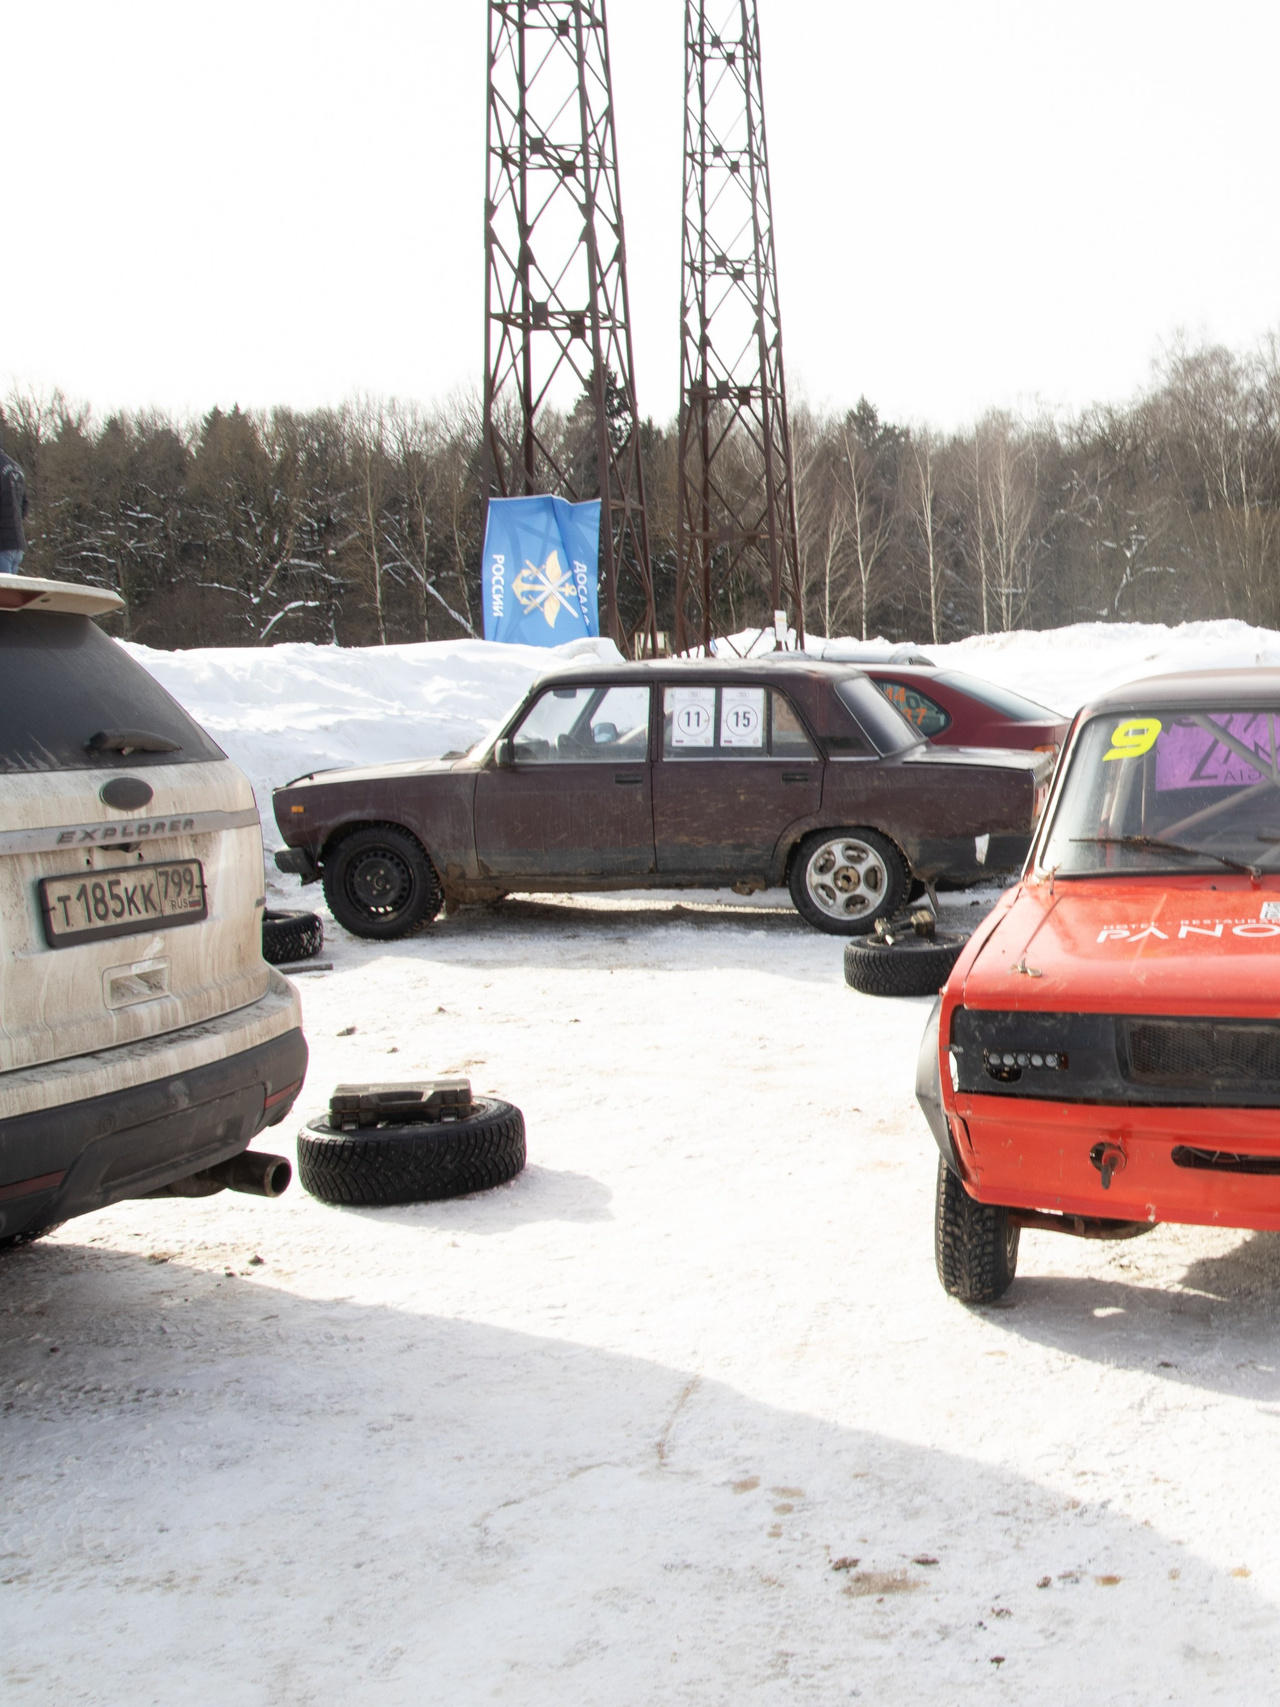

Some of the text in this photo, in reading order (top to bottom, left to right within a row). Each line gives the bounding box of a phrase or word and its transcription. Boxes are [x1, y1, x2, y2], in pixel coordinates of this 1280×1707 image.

[492, 554, 505, 617] РОССИИ
[573, 560, 590, 626] ДОСАА
[885, 686, 906, 703] 14
[685, 711, 700, 727] 11
[733, 711, 751, 727] 15
[1102, 718, 1163, 761] 9
[56, 818, 195, 845] EXPLORER
[158, 867, 195, 900] 799
[171, 898, 189, 910] RUS
